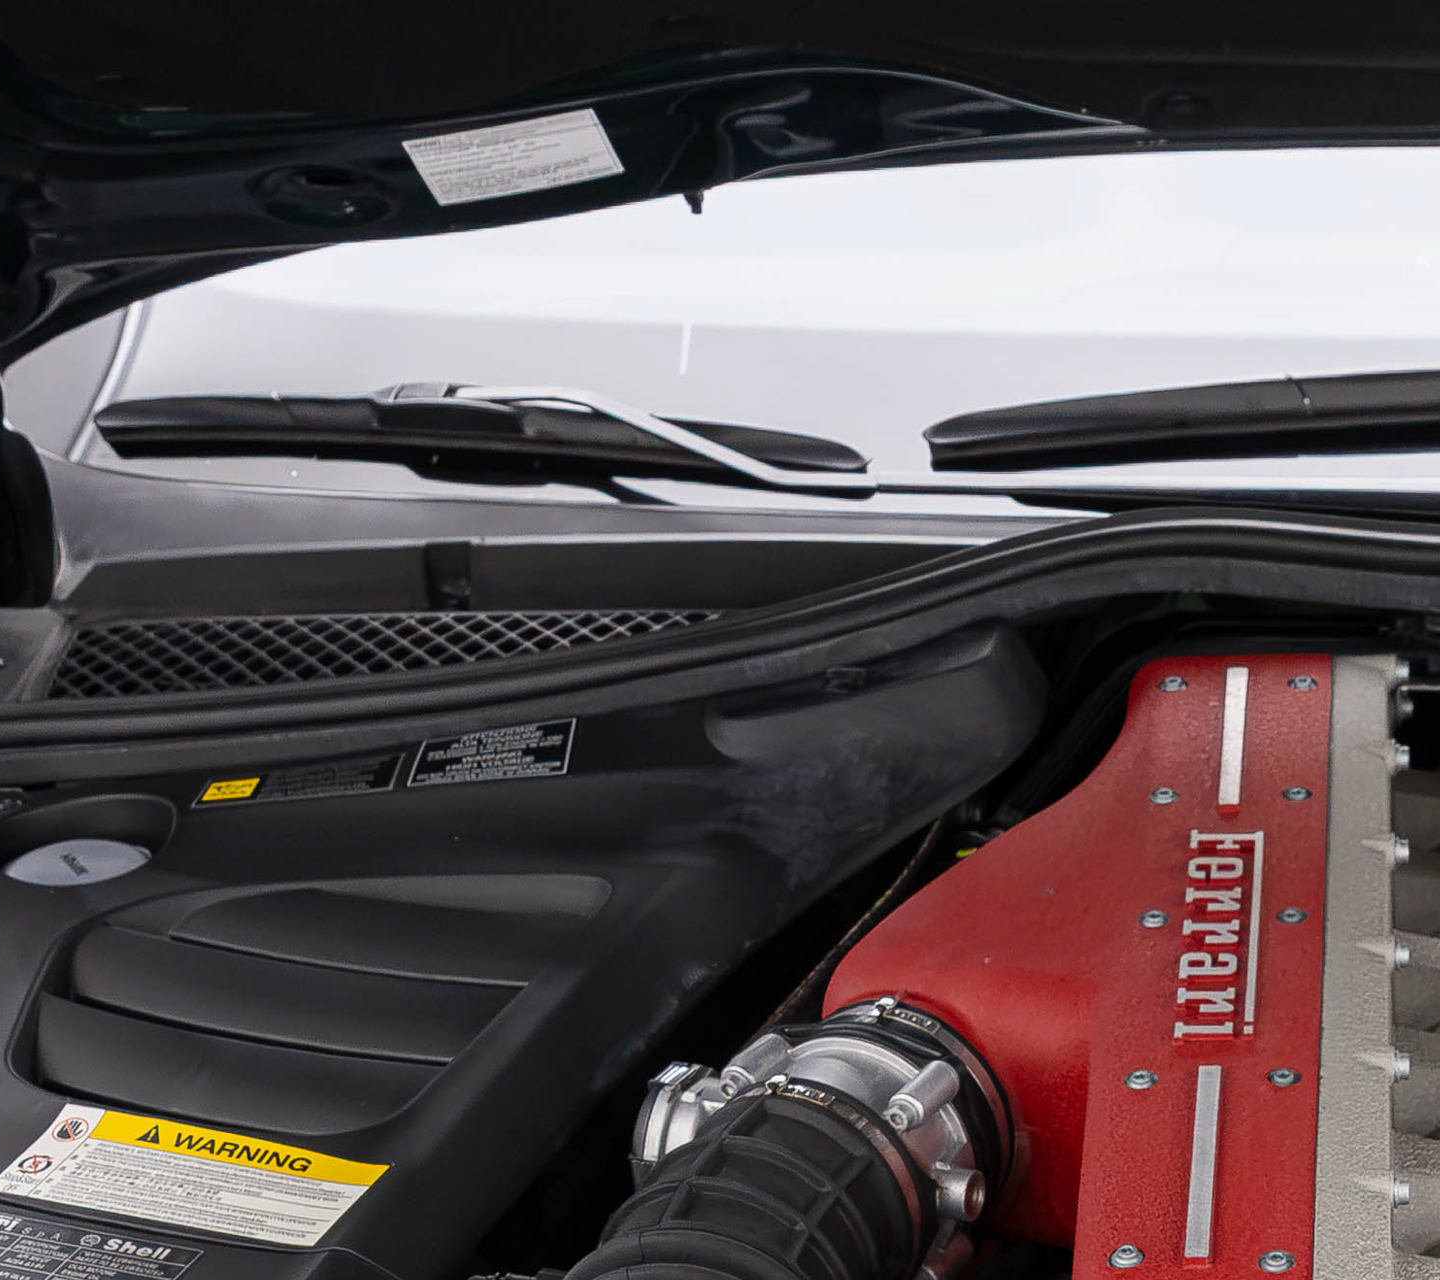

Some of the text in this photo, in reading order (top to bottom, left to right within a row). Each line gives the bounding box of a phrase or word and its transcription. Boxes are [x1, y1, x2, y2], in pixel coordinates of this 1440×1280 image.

[1173, 829, 1263, 1041] Ferrari
[175, 1132, 312, 1172] WARNING
[103, 1238, 172, 1259] Shell
